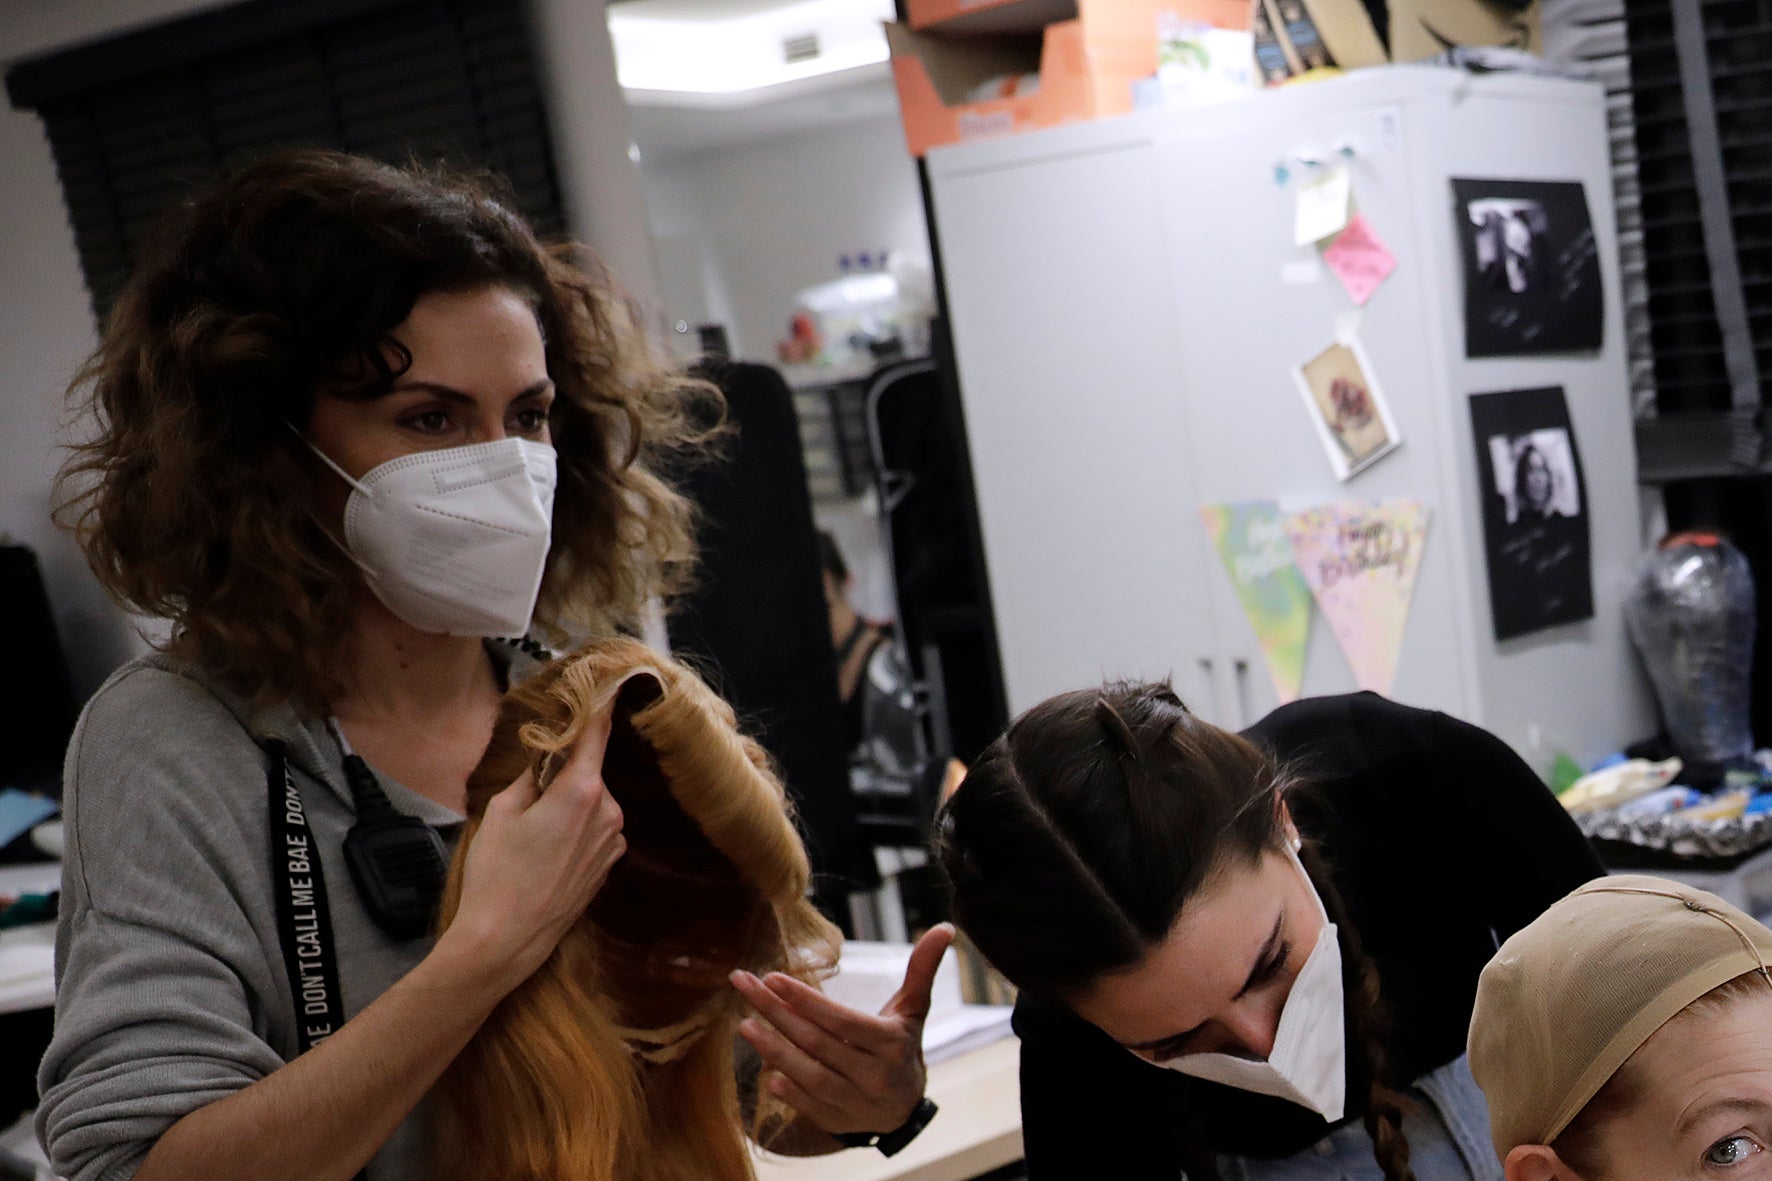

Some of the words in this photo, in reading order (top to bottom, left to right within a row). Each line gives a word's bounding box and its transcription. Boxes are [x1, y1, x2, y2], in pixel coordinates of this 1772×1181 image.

[286, 833, 310, 873] BAE
[289, 877, 315, 908] ME
[294, 909, 322, 957] CALL
[299, 959, 328, 1015] DON'T
